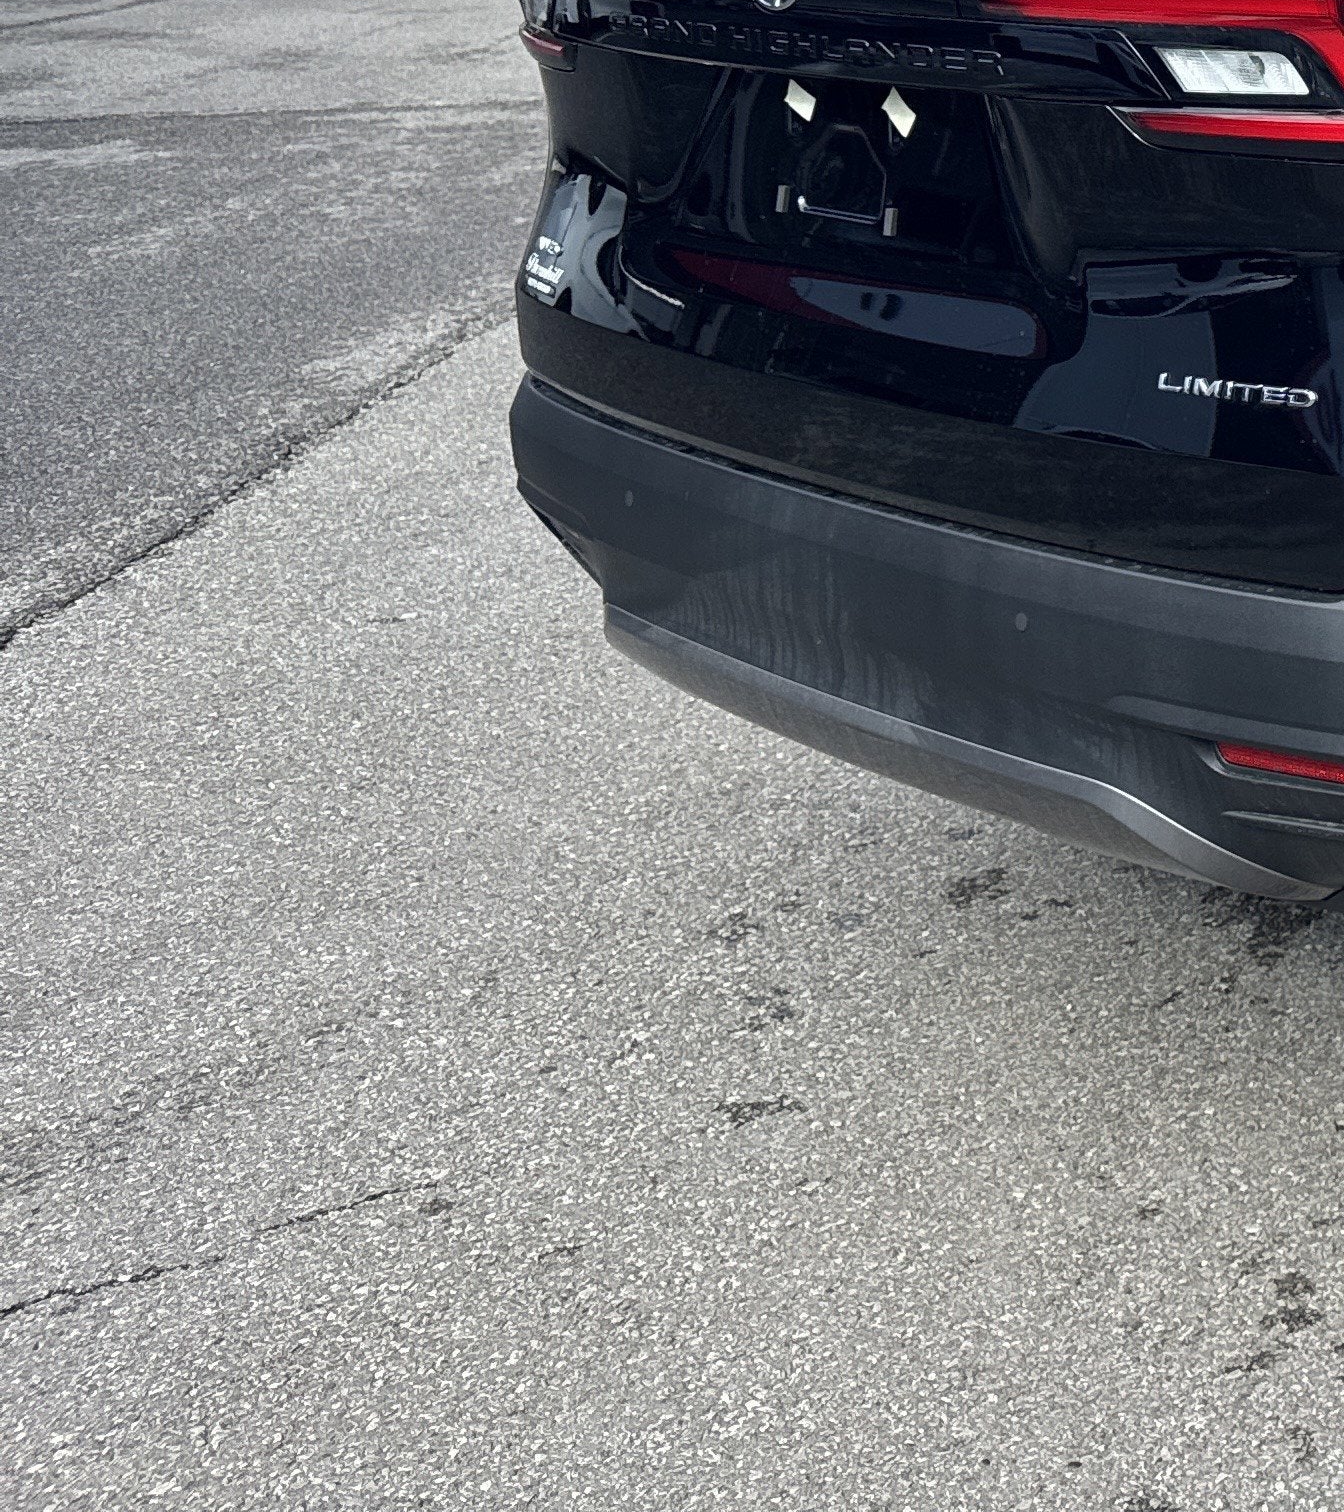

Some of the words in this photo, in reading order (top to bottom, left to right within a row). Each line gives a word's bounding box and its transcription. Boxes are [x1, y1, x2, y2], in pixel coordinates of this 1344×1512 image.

[609, 11, 717, 47] GRAND
[728, 25, 1004, 76] HIGHLANDER
[1157, 372, 1319, 408] LIMITED
